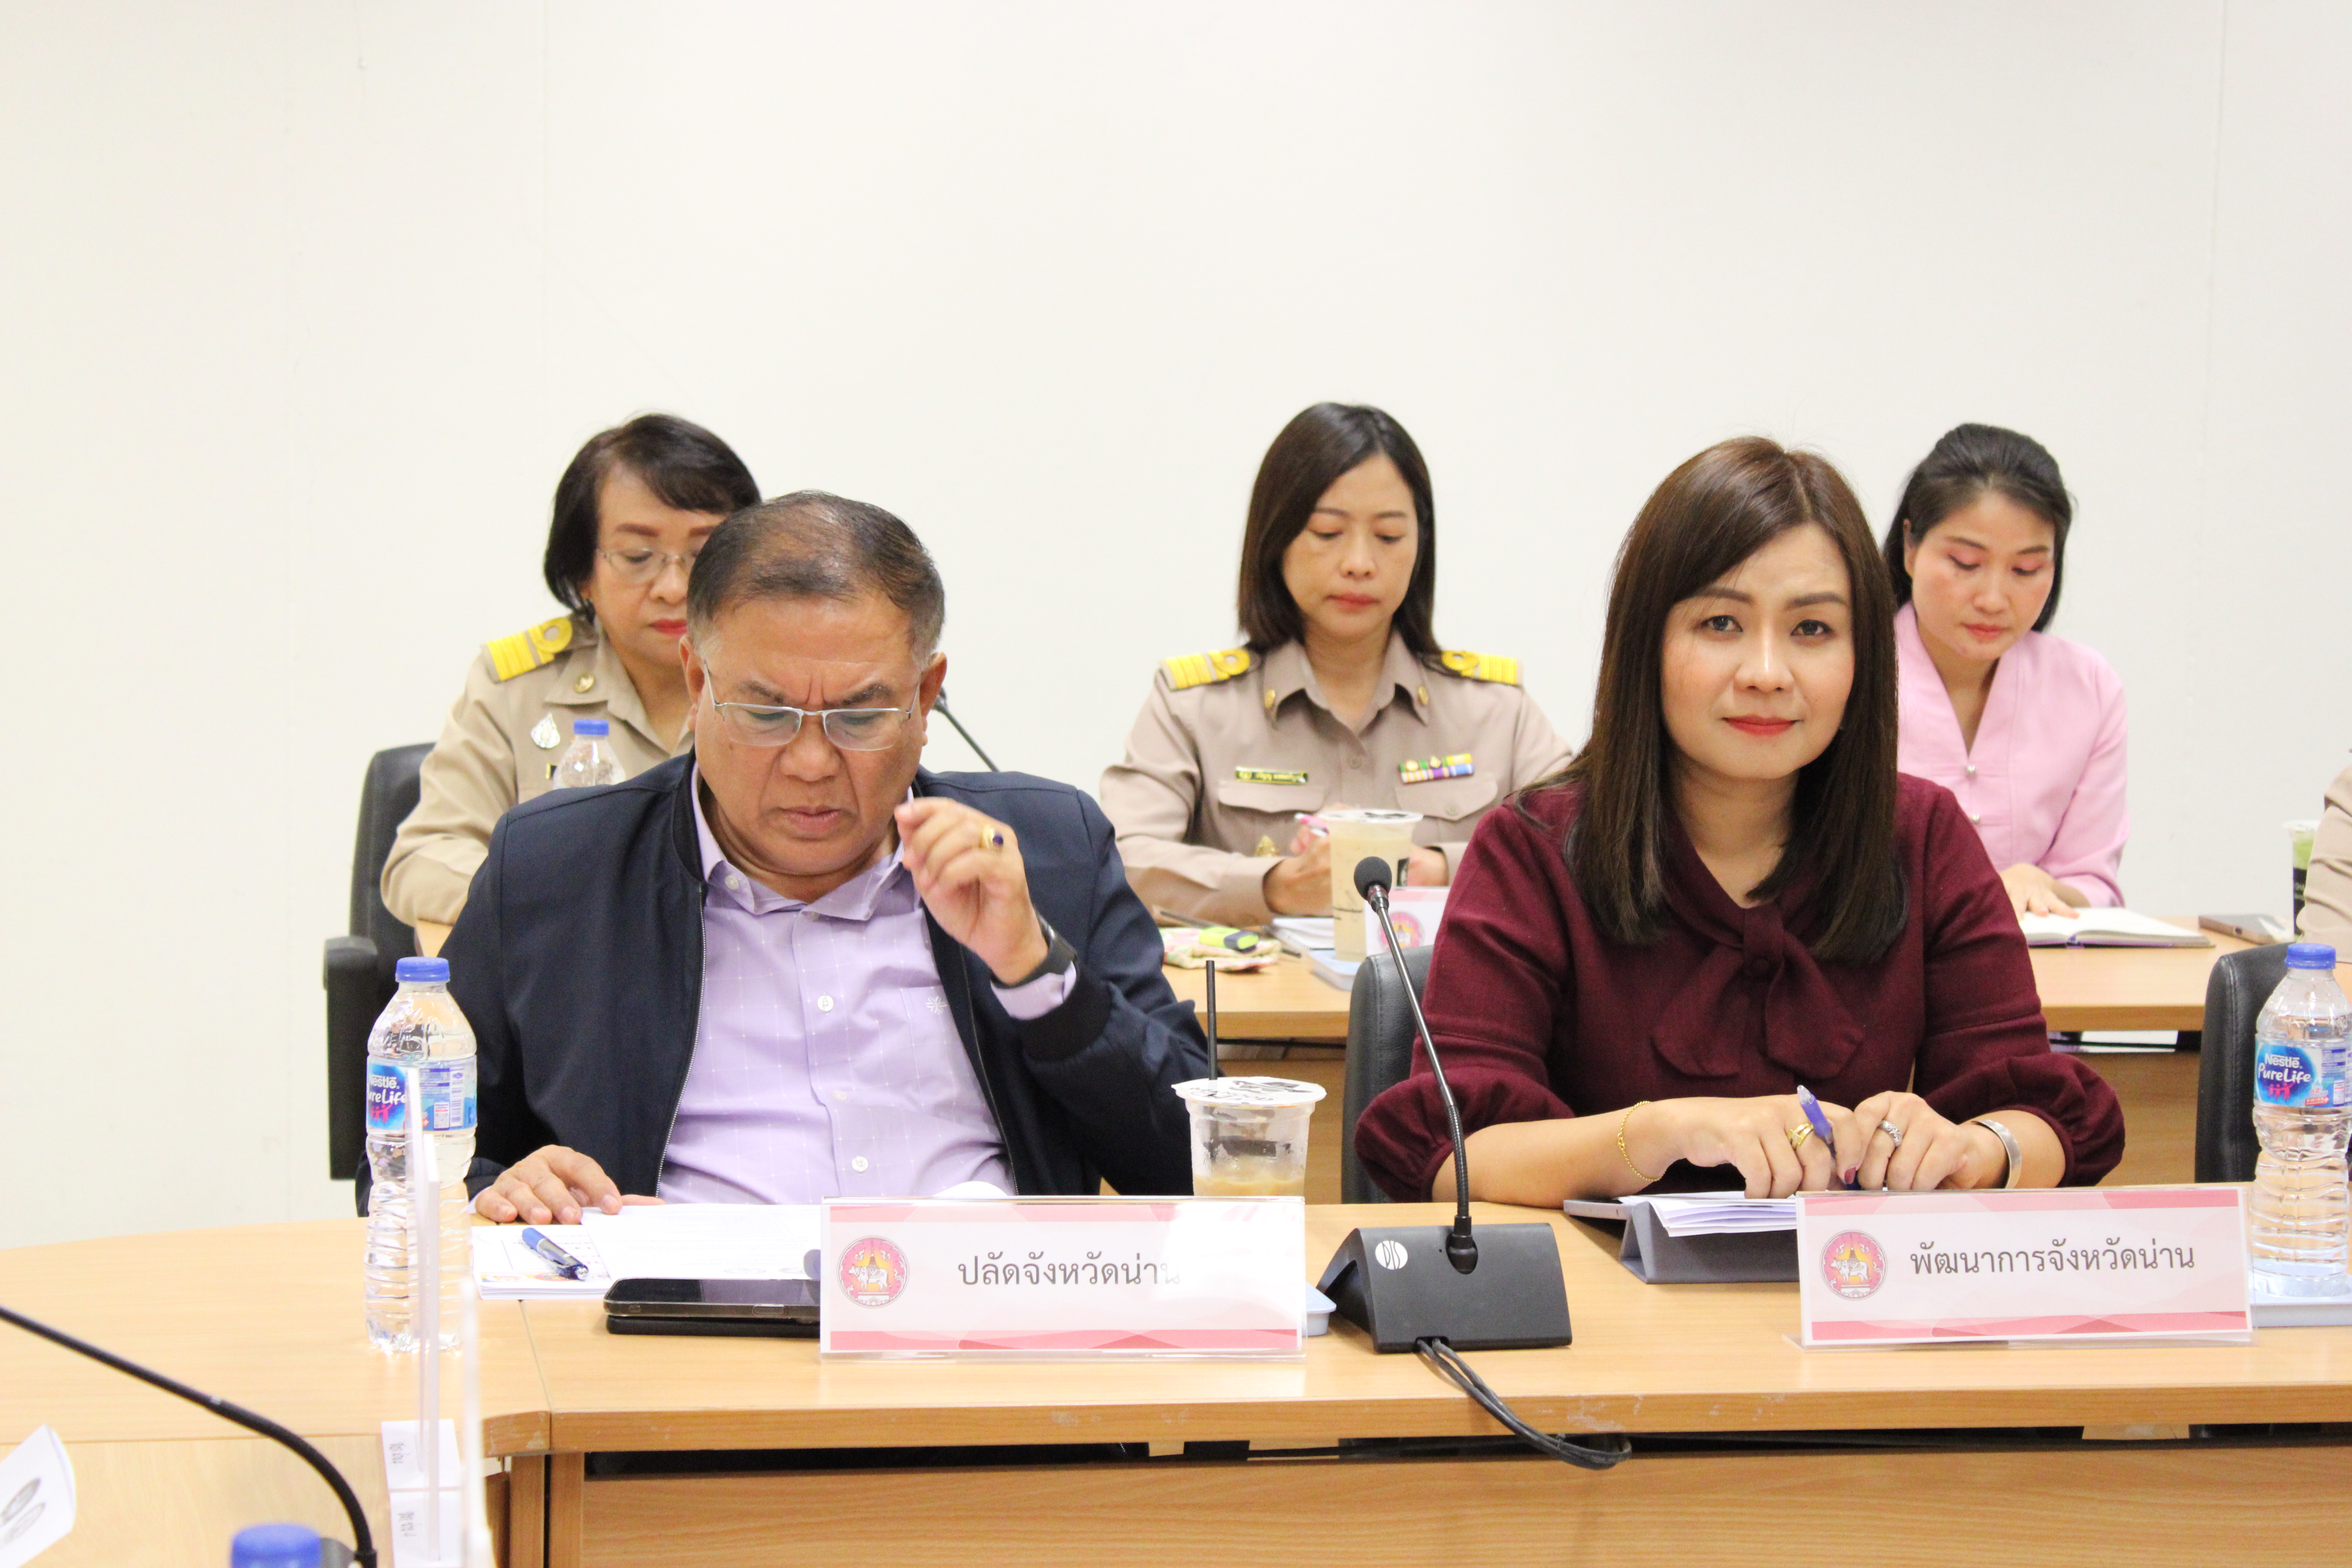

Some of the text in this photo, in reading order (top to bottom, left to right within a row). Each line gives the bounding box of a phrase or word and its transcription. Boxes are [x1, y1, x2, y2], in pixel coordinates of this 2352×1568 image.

[1910, 1237, 2195, 1274] พัฒนาการจังหวัดน่าน
